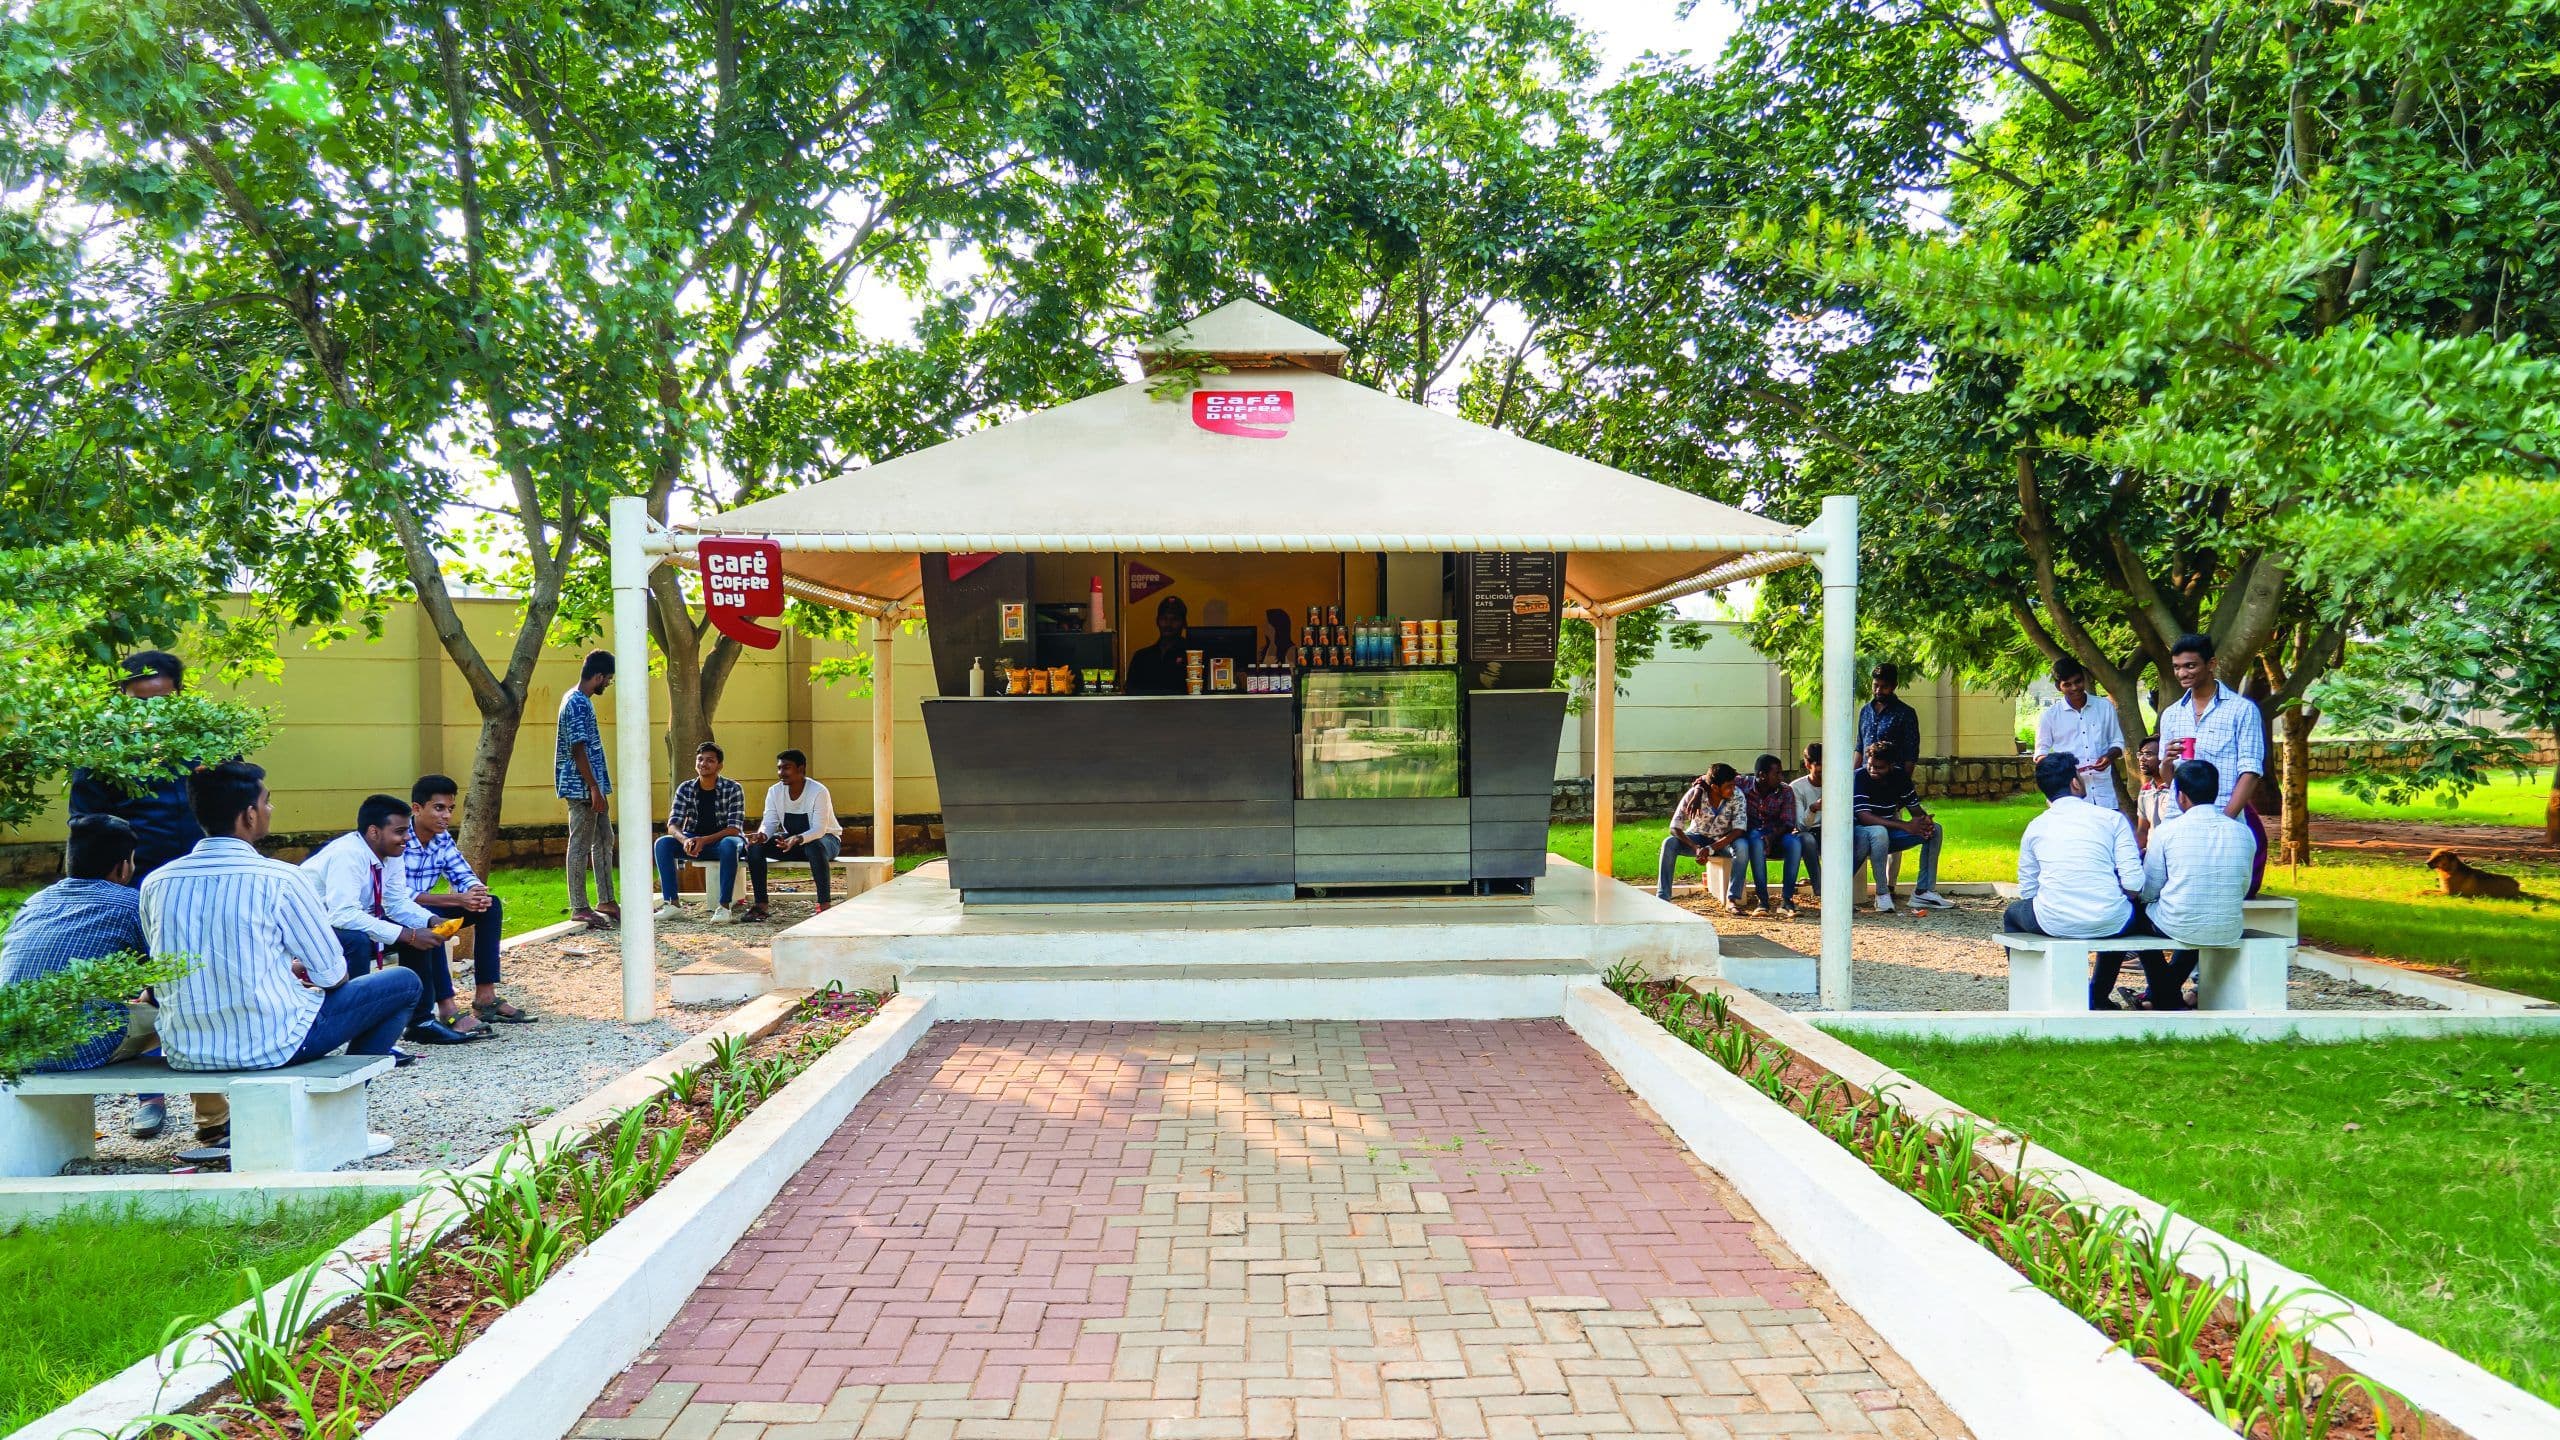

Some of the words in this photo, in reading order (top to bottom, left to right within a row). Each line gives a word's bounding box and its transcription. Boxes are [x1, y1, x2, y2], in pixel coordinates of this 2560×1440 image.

[708, 550, 768, 575] Café
[710, 574, 770, 592] Coffee
[712, 591, 746, 608] Day
